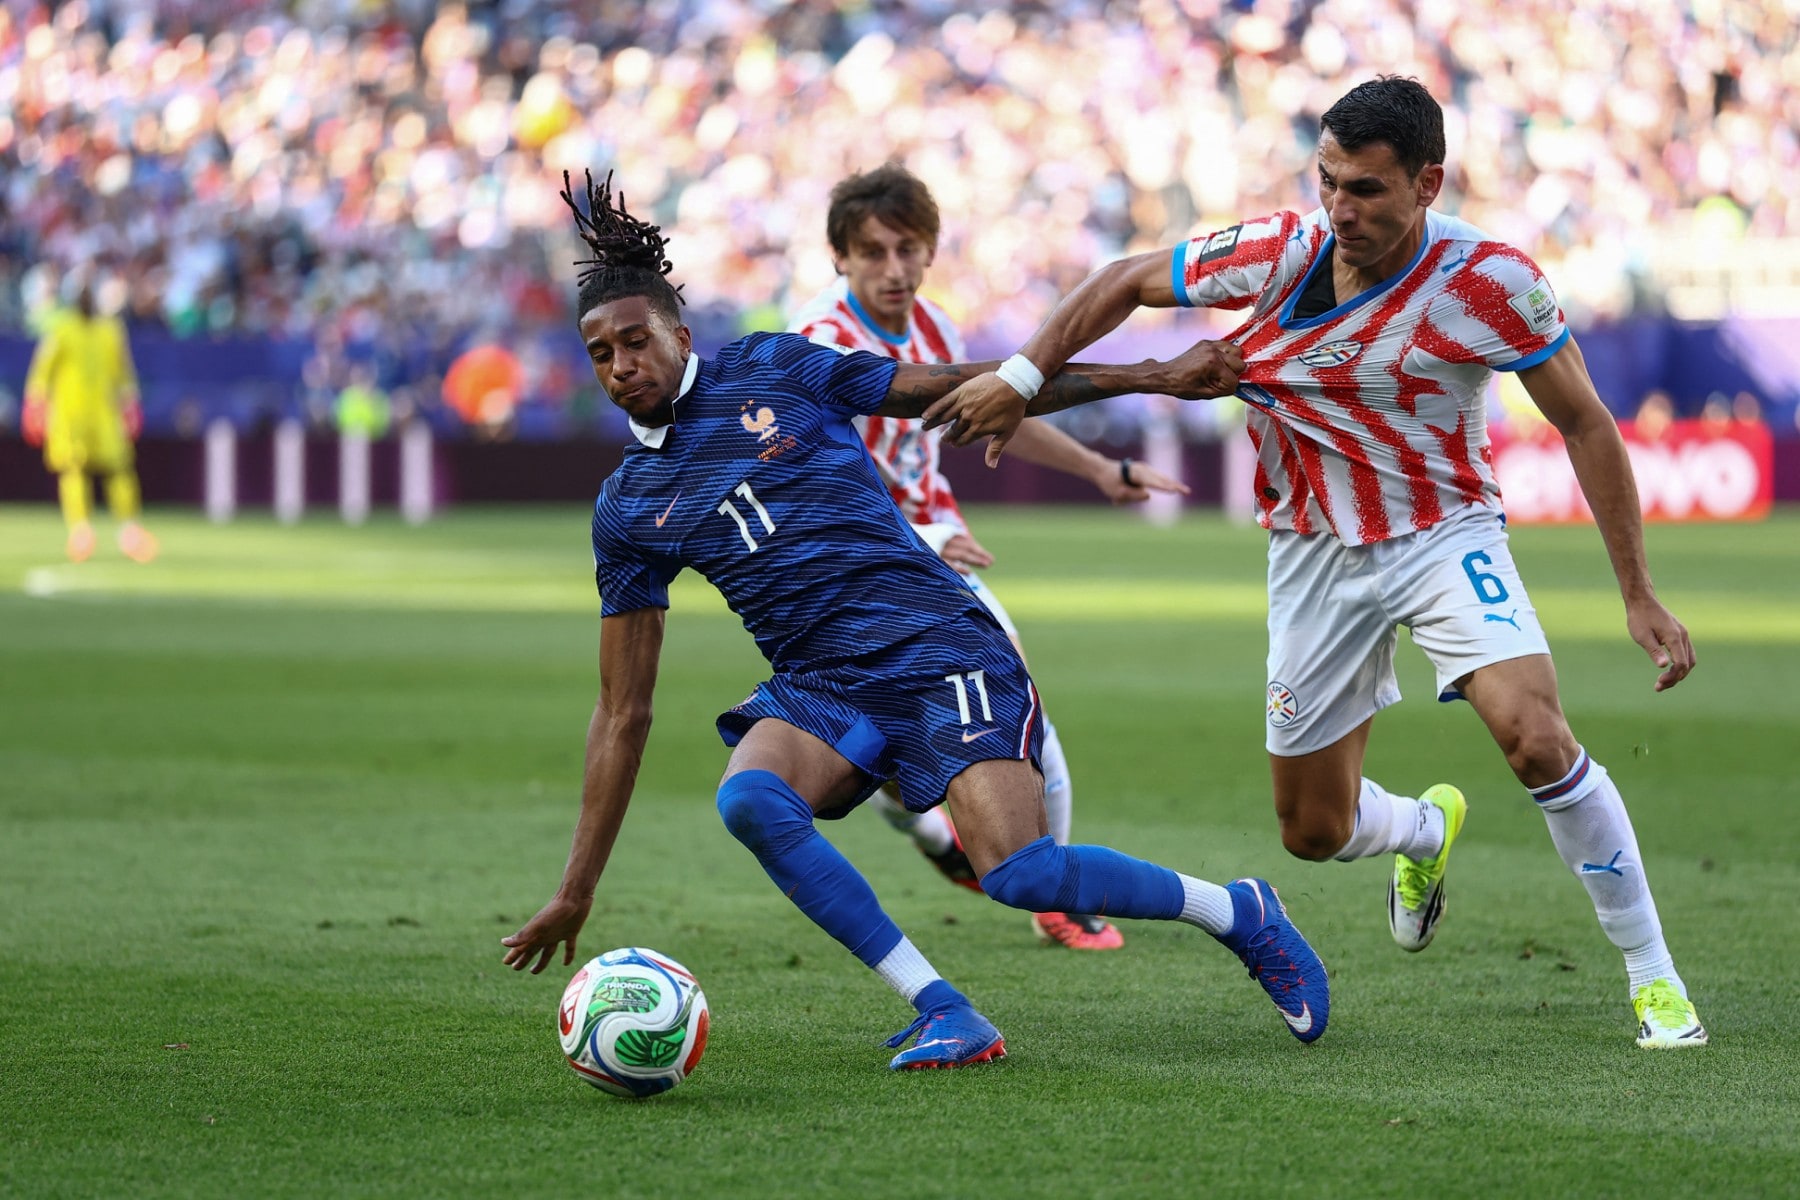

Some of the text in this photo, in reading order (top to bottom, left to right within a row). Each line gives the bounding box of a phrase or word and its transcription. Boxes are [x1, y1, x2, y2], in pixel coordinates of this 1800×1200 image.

[717, 481, 776, 553] 11
[1461, 550, 1509, 604] 6
[945, 669, 993, 724] 11
[604, 982, 651, 991] TRIONDA
